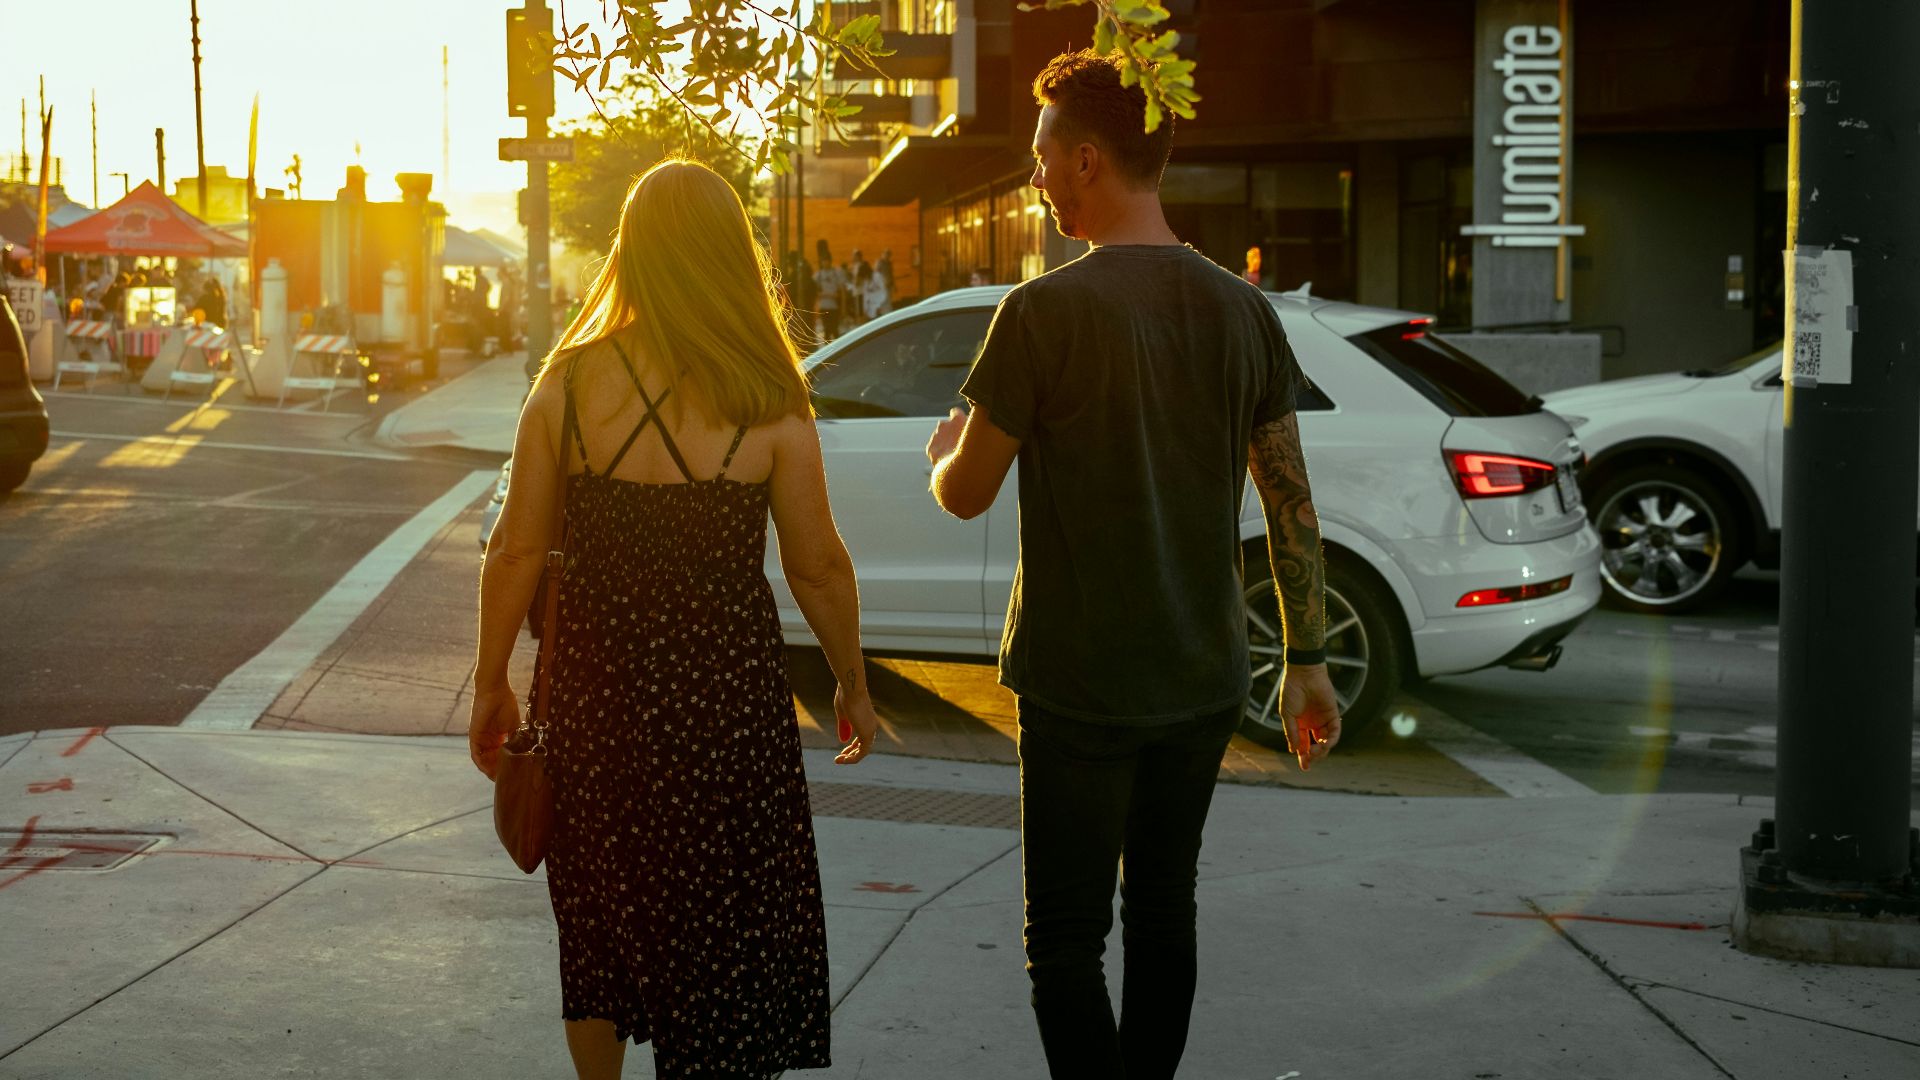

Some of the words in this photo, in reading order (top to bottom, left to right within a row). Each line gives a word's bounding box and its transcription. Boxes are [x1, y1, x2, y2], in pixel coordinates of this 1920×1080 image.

[544, 144, 566, 154] WAY
[9, 286, 36, 303] EET
[16, 308, 35, 325] ED
